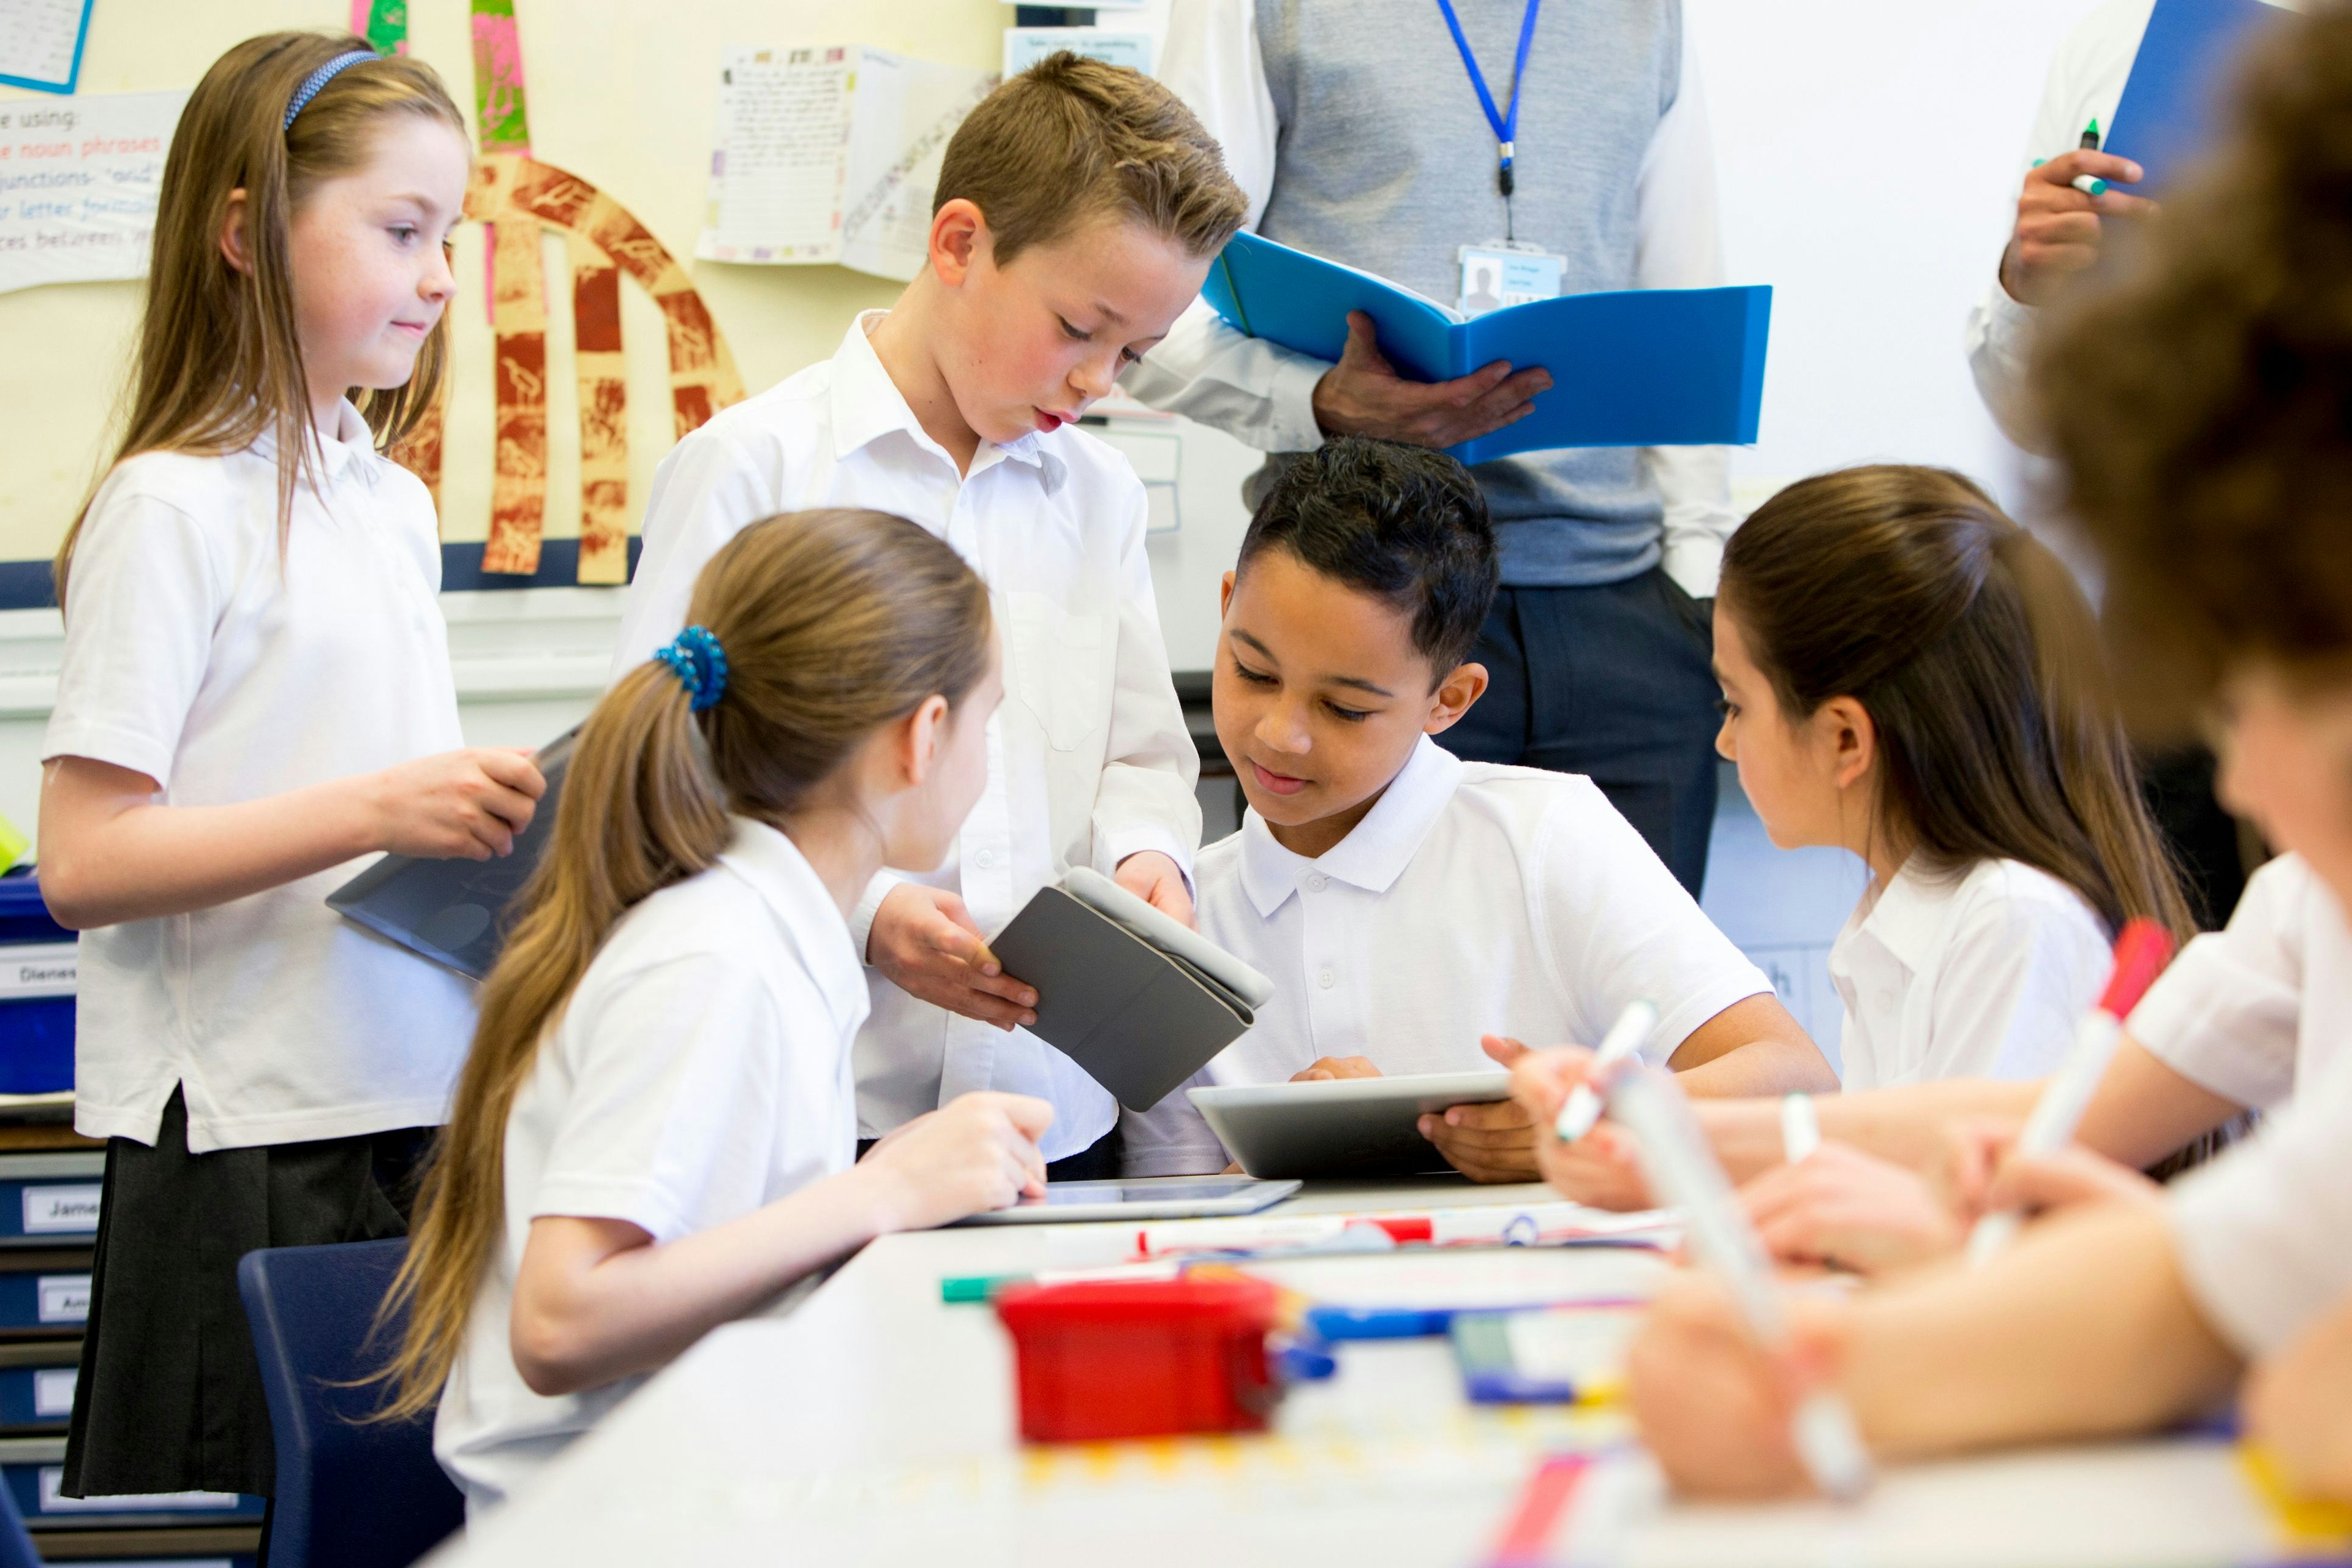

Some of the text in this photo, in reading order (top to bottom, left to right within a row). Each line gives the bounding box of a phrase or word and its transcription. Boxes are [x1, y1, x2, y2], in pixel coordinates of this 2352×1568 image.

[19, 141, 72, 159] noun
[81, 135, 159, 159] phrases
[19, 198, 72, 219] letter
